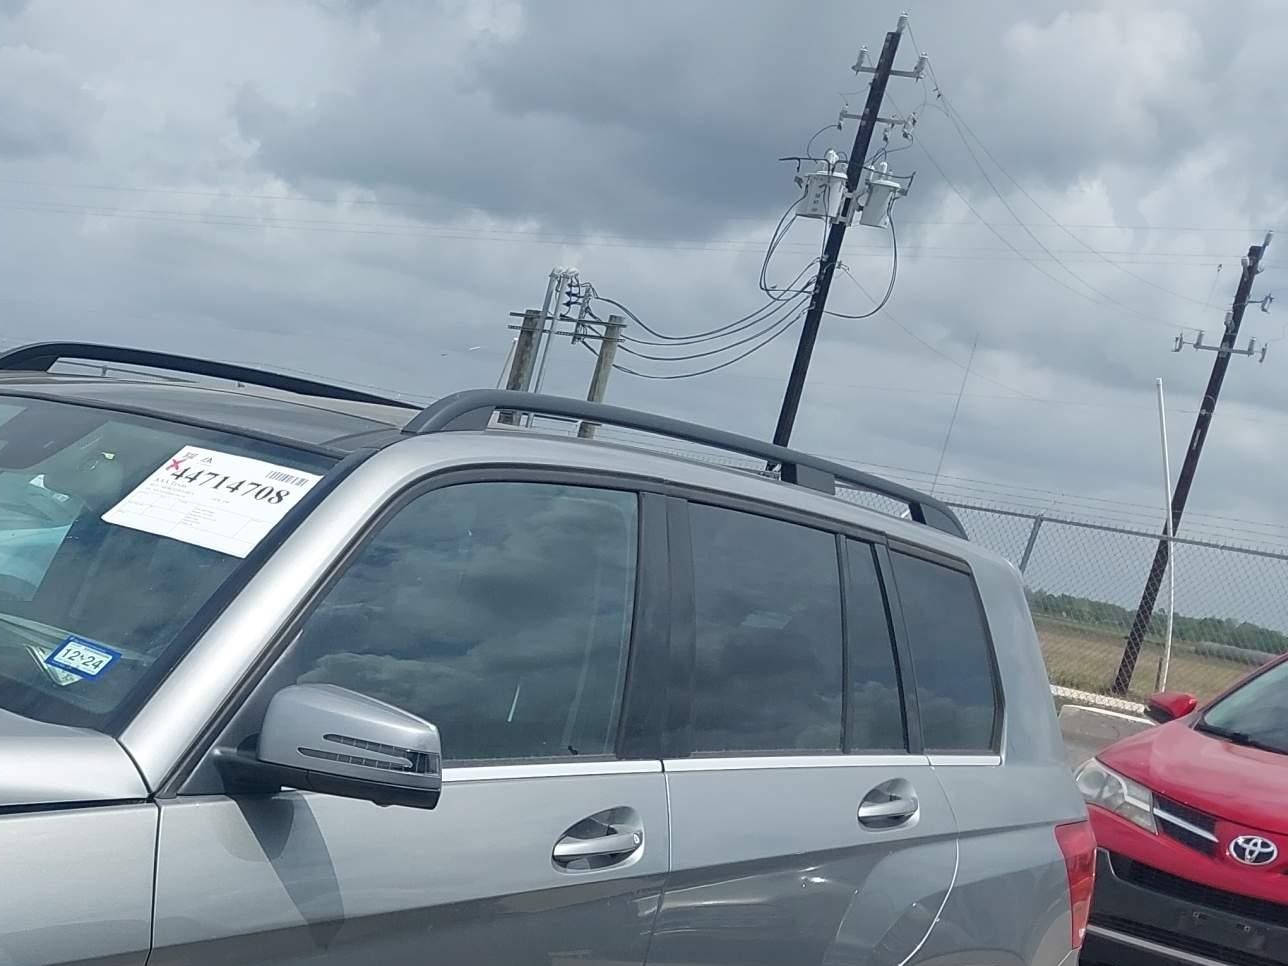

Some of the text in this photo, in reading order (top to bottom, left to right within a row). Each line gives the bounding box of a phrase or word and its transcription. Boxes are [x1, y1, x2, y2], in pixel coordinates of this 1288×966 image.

[170, 466, 291, 505] 44714708
[62, 648, 81, 662] 12
[82, 655, 105, 670] 24
